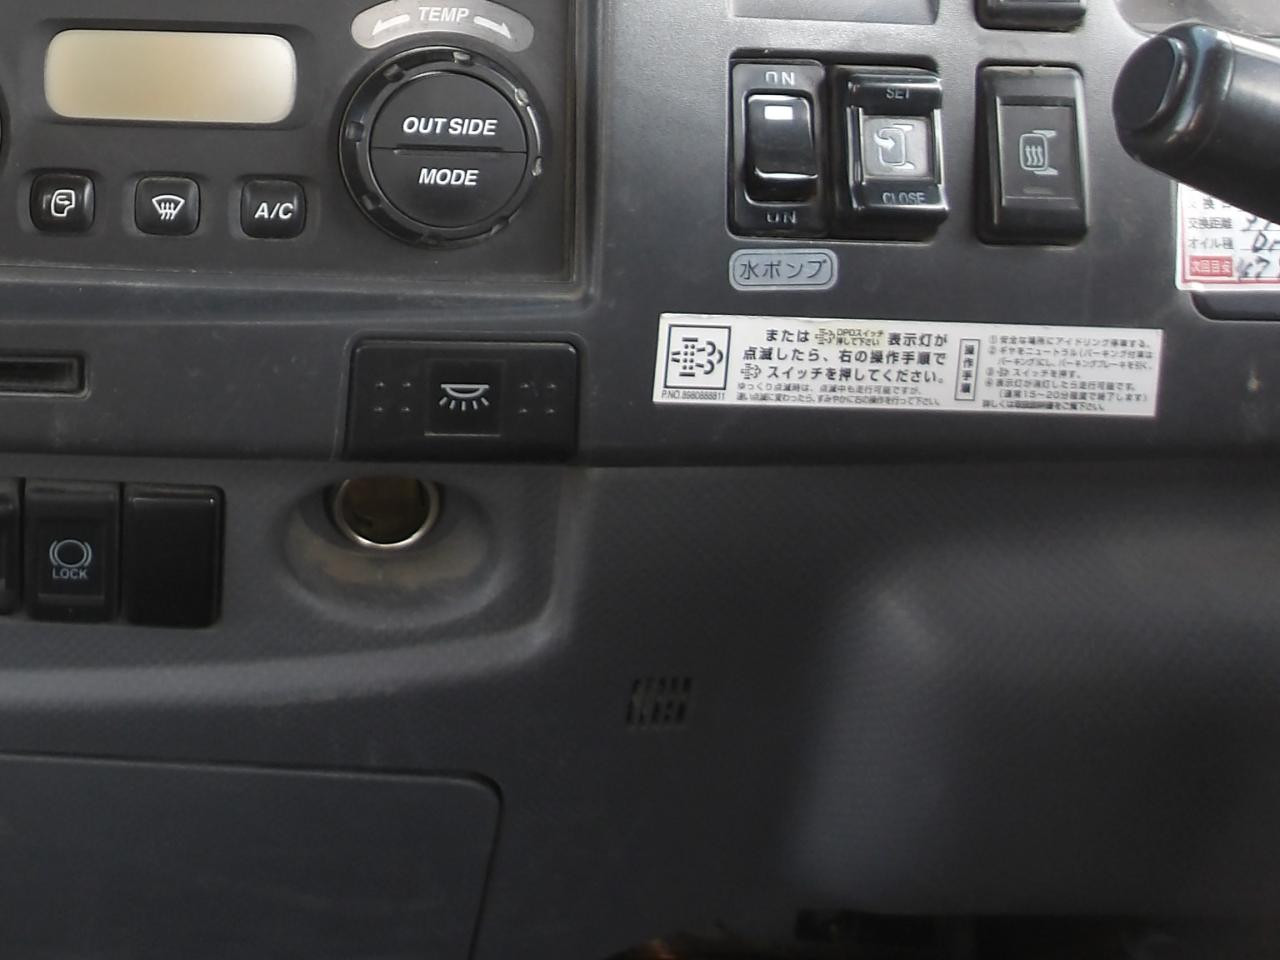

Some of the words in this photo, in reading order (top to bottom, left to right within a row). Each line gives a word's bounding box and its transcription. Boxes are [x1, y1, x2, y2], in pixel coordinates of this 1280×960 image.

[419, 7, 470, 23] TEMP
[765, 71, 796, 86] ON
[418, 169, 479, 186] MODE
[882, 192, 926, 204] CLOSE
[254, 202, 295, 219] A/C
[767, 211, 797, 224] ON
[739, 259, 827, 280] 水ポンプ
[765, 328, 810, 343] または
[887, 332, 948, 348] 表示灯が
[52, 568, 88, 580] LOCK
